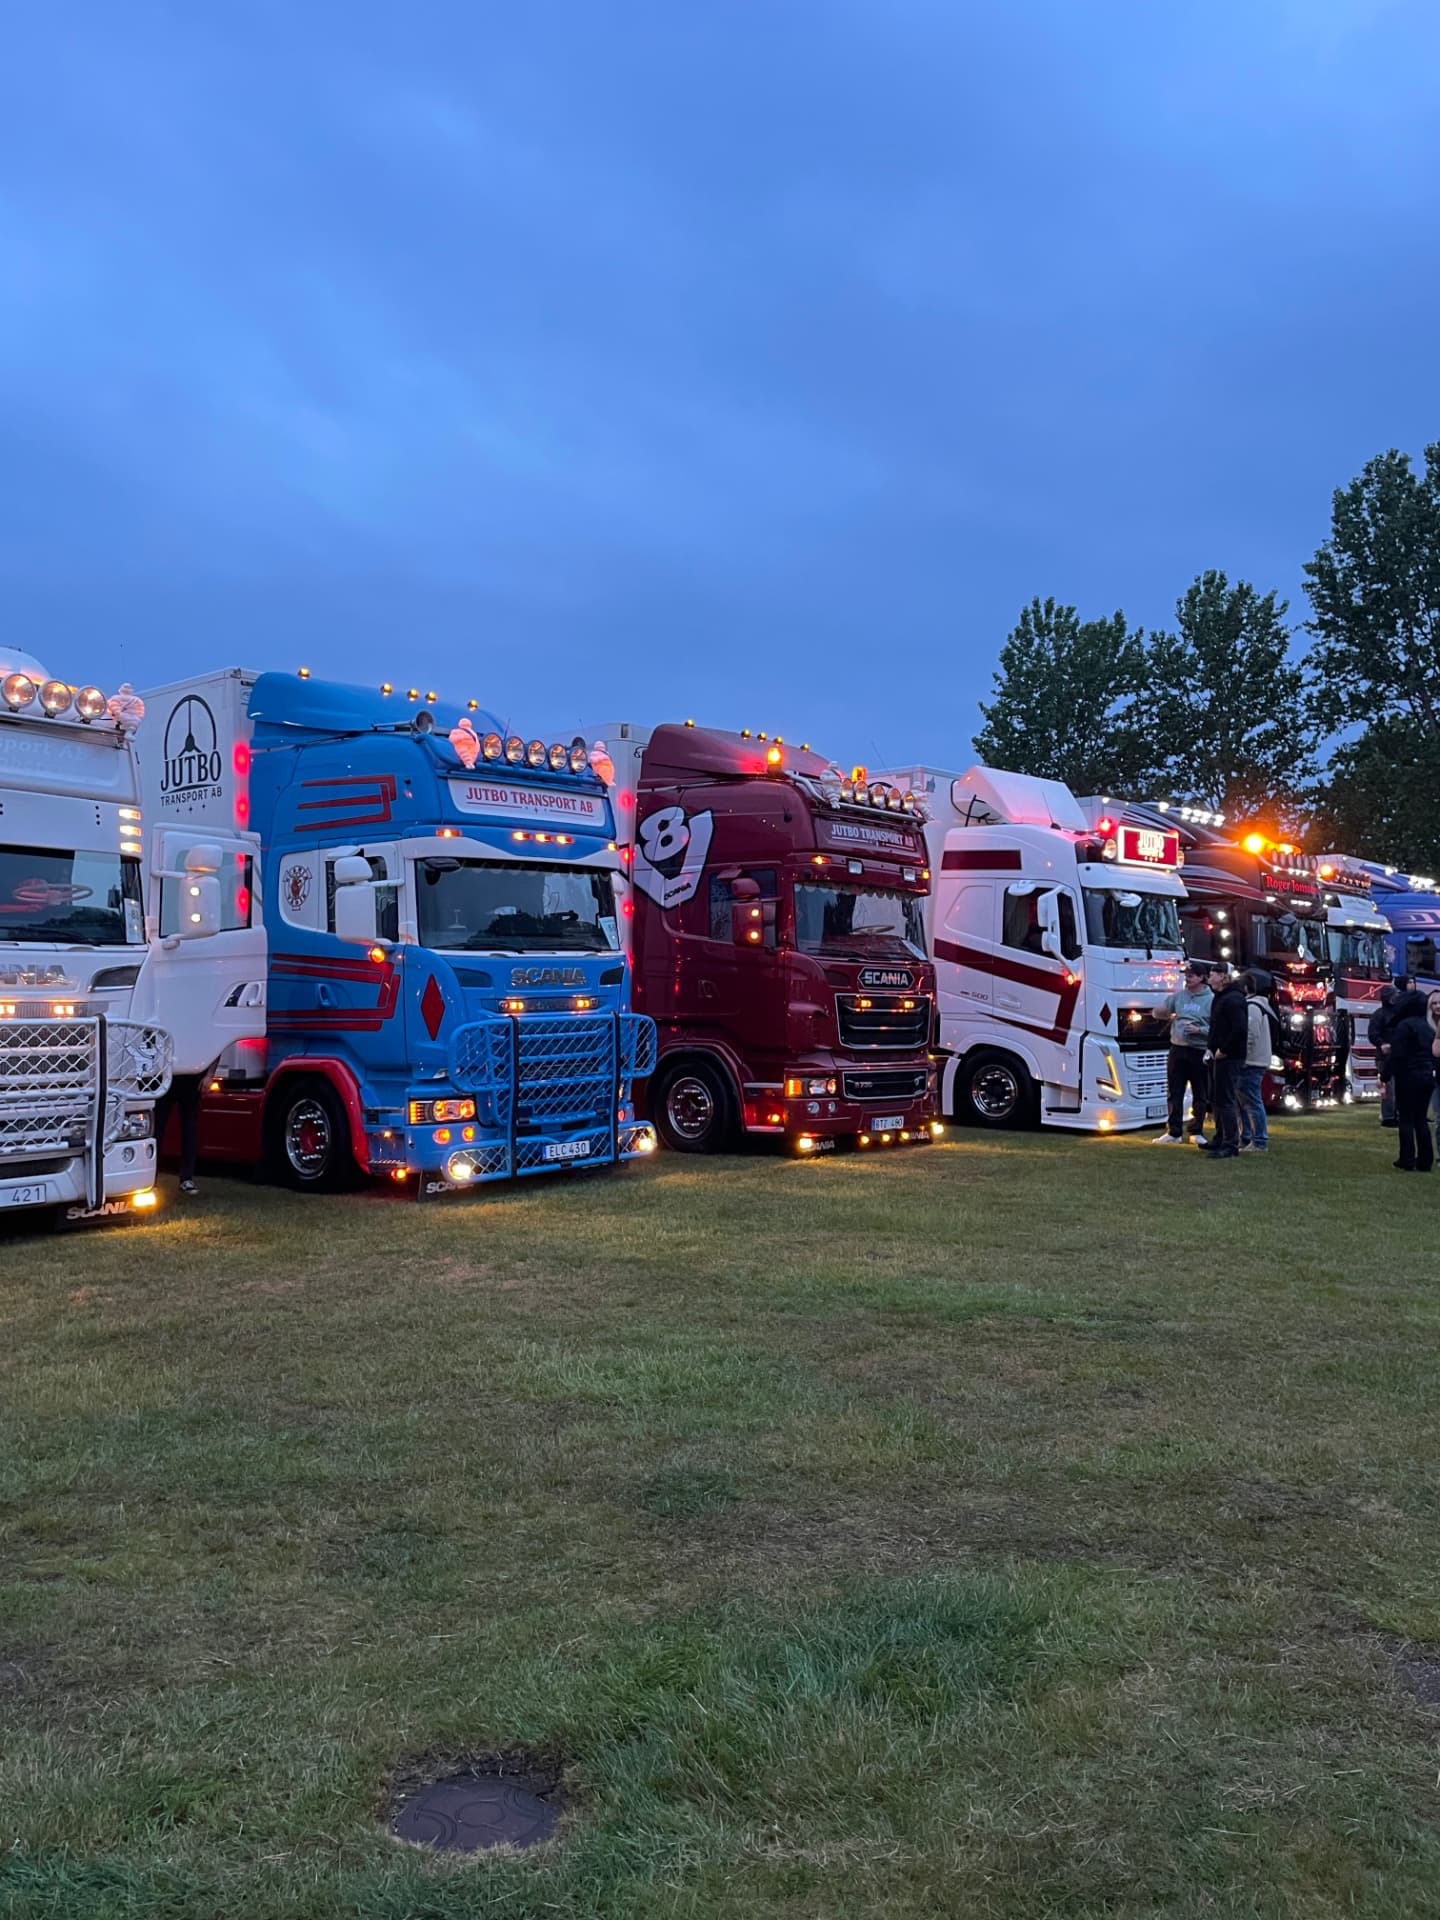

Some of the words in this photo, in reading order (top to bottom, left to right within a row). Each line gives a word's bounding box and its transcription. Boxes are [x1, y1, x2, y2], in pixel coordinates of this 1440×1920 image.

[160, 750, 222, 792] JUTBO
[160, 788, 209, 807] TRANSPORT
[211, 786, 222, 797] AB
[466, 786, 508, 803] JUTBO
[510, 790, 577, 811] TRANSPORT
[580, 800, 594, 813] AB
[832, 824, 859, 838] JUTBO
[511, 967, 587, 987] SCANIA
[863, 971, 910, 986] SCANIA
[549, 1145, 568, 1158] ELC
[569, 1142, 588, 1155] 430
[12, 1187, 41, 1203] 421
